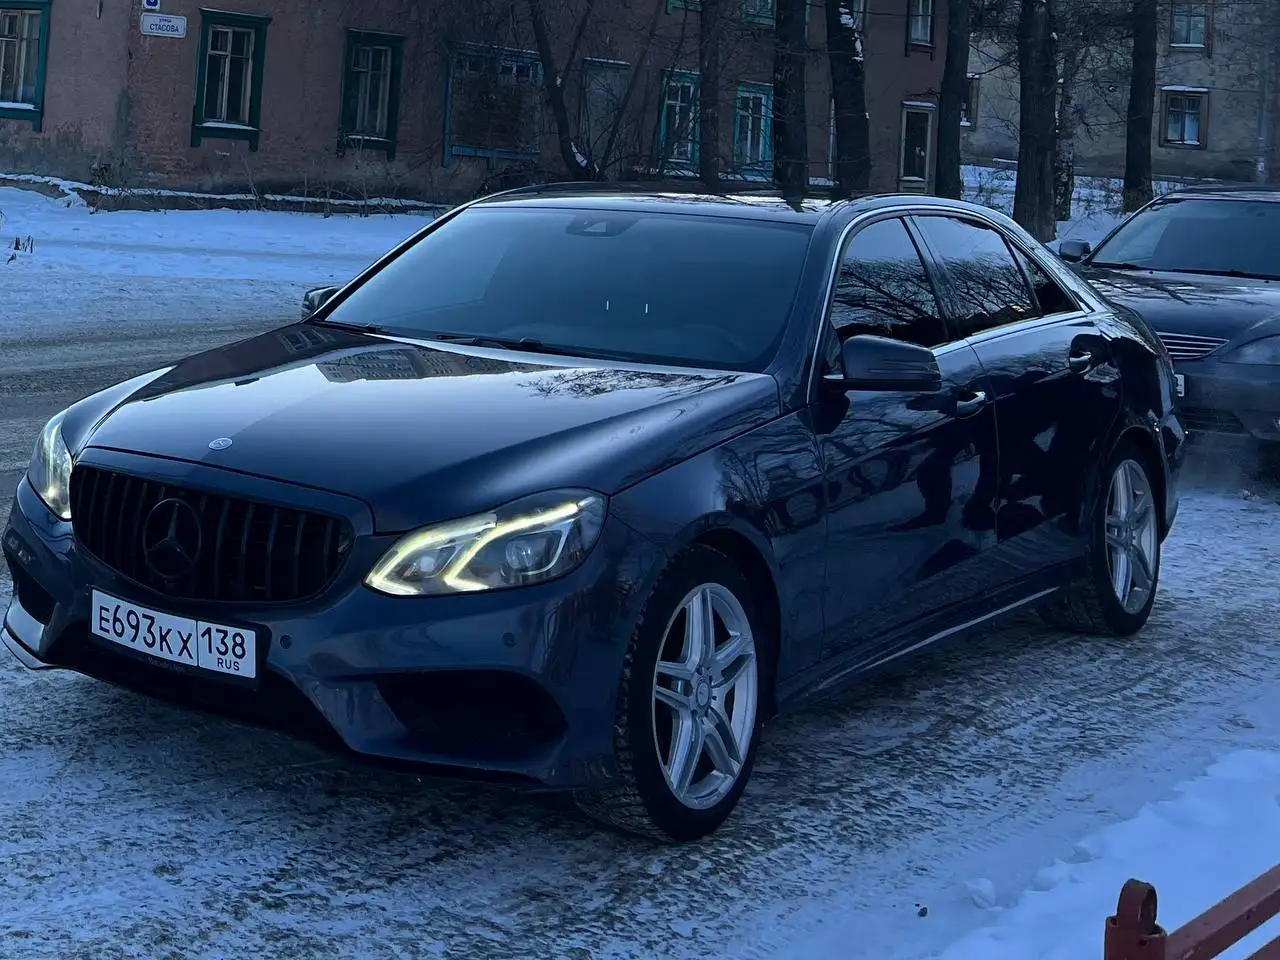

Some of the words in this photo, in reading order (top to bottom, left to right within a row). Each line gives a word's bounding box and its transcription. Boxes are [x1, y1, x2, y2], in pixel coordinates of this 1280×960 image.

[150, 23, 179, 32] СТАСОВА
[200, 626, 246, 660] 138
[217, 657, 240, 671] RUS
